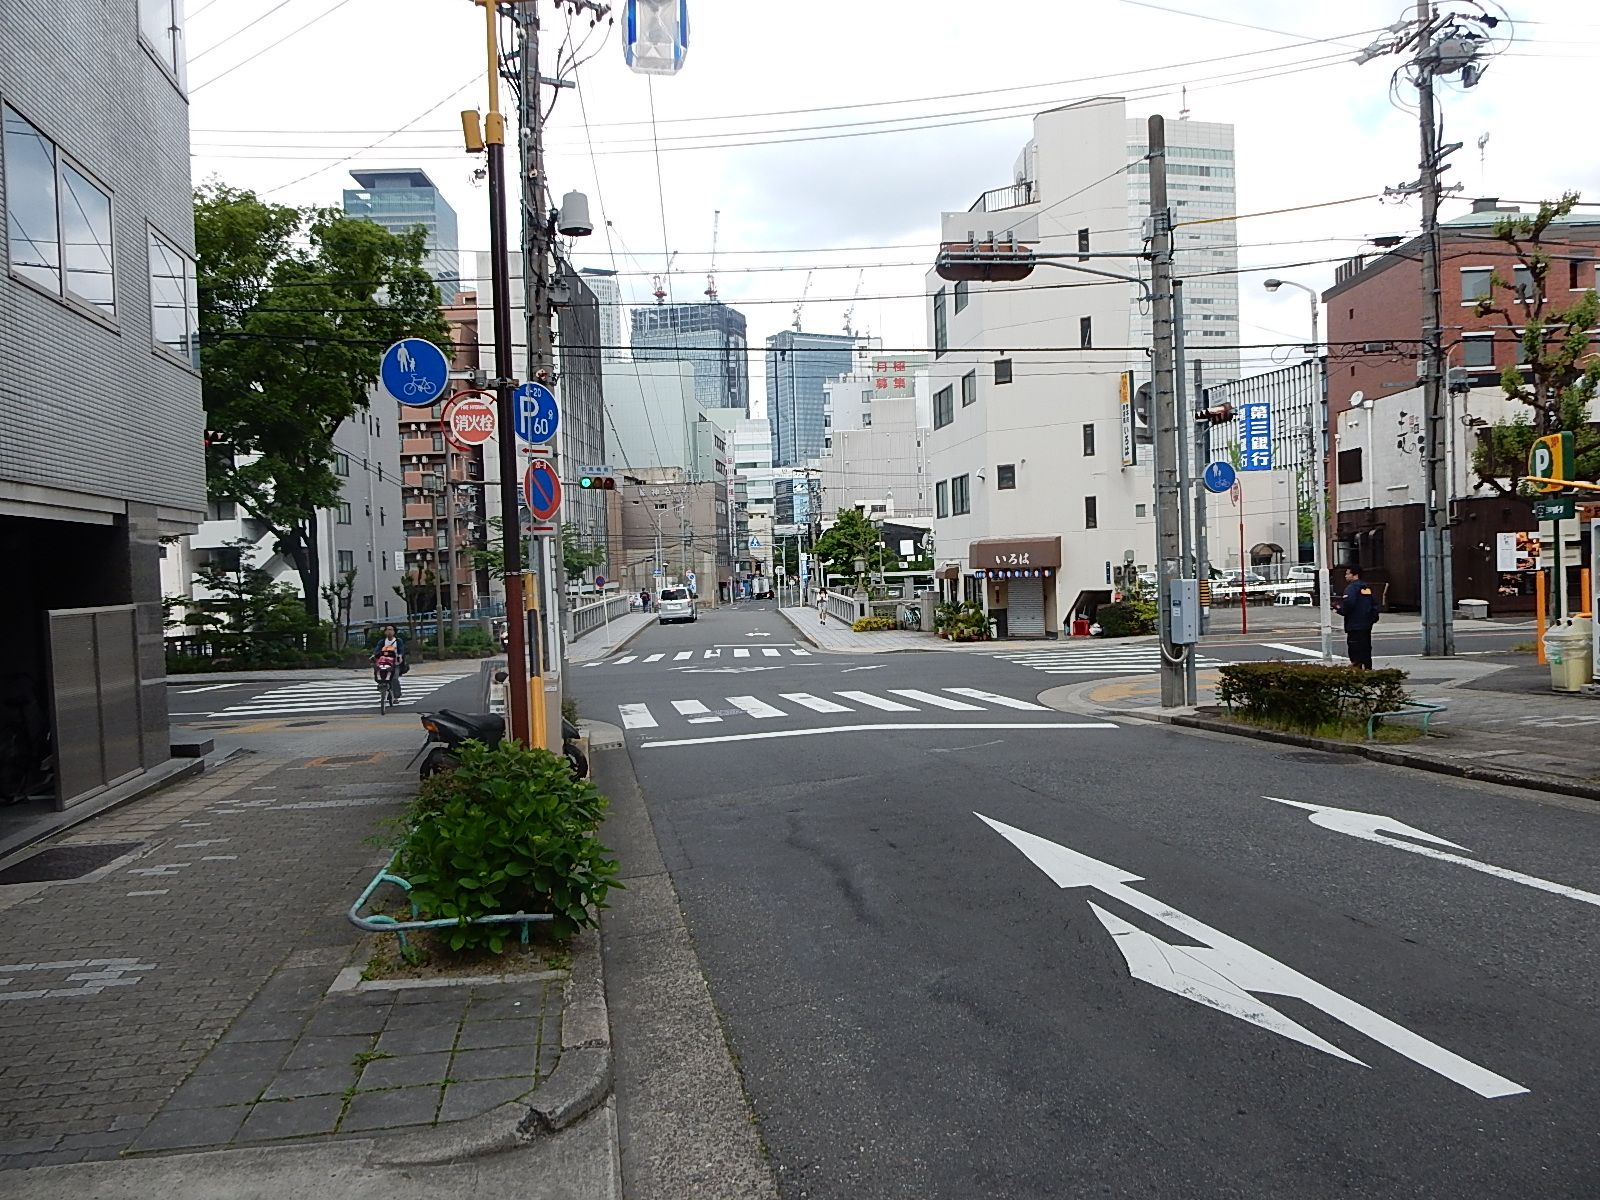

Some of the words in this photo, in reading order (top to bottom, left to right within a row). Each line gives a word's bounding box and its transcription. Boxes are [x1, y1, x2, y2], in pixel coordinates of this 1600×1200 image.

[455, 414, 494, 432] 消火栓
[519, 395, 540, 434] P
[534, 418, 548, 435] 60
[1250, 405, 1270, 466] 第三銀行
[1535, 448, 1550, 483] P
[995, 553, 1030, 565] いろは
